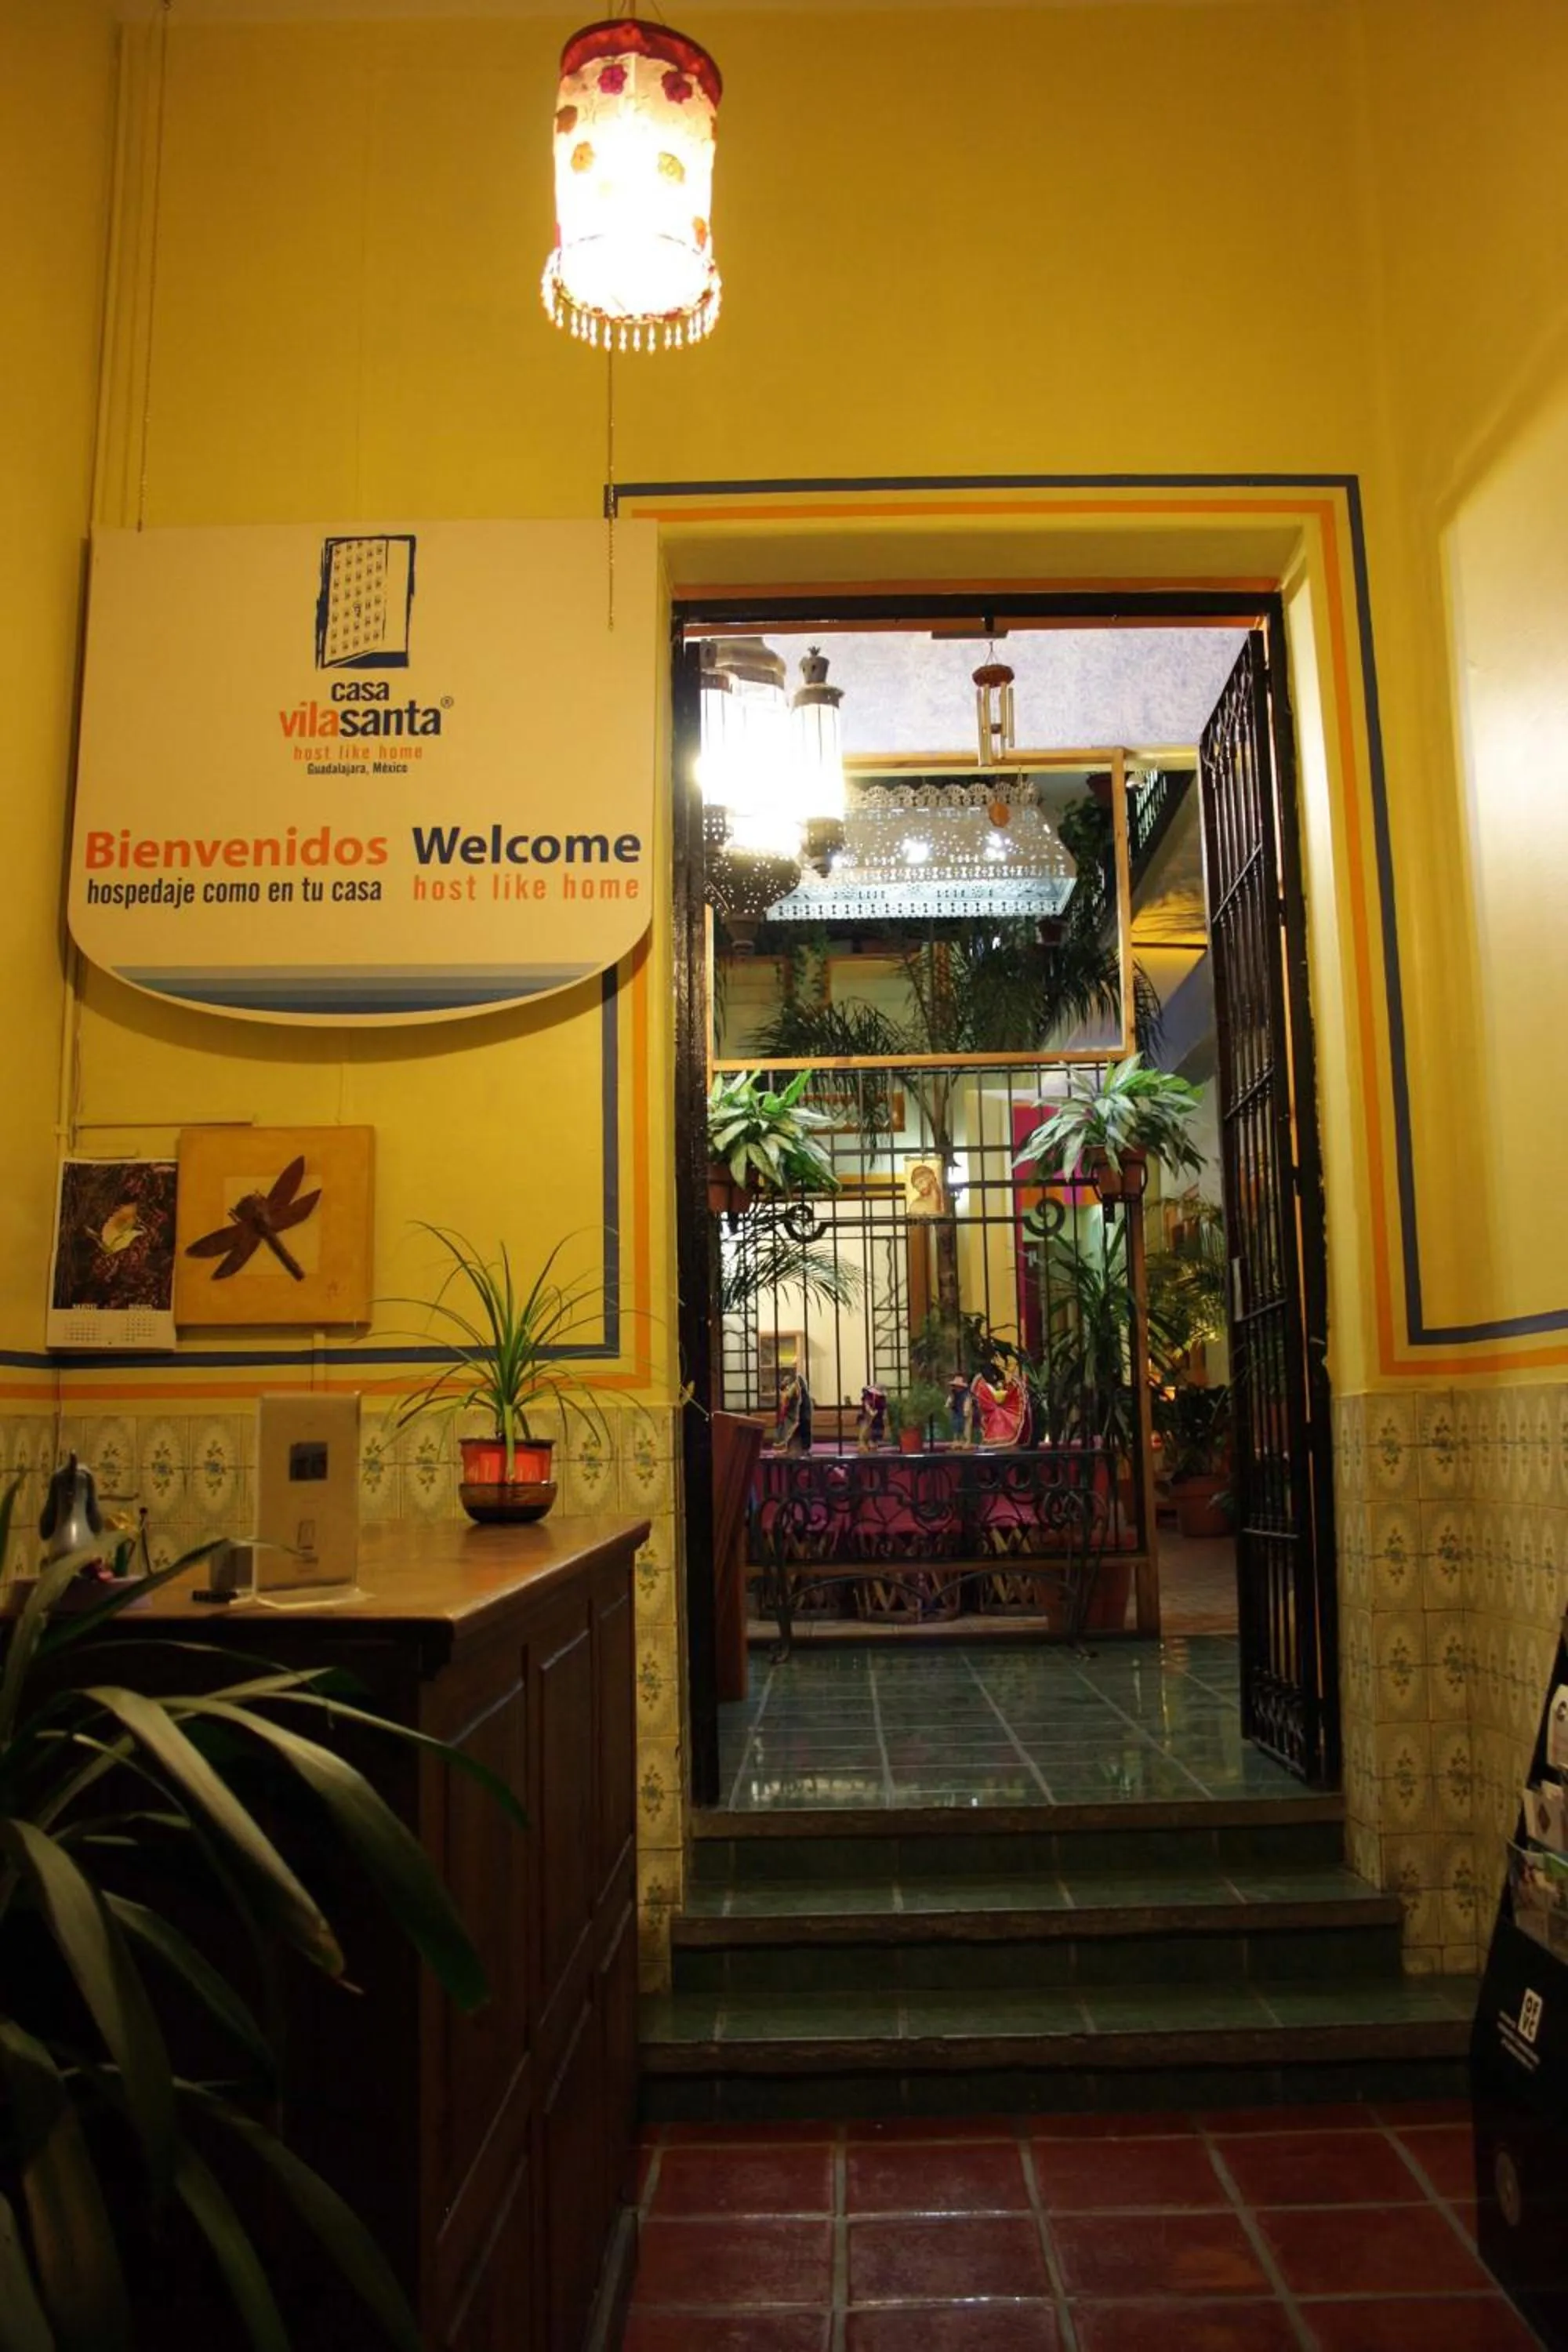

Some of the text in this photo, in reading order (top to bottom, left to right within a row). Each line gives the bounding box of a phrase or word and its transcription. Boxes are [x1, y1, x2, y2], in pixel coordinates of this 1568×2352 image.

[331, 681, 390, 702] casa
[293, 745, 423, 760] host like home
[372, 761, 408, 773] México
[85, 826, 389, 869] Bienvenidos
[412, 824, 641, 864] Welcome
[87, 877, 383, 909] hospedaje como en tu casa
[413, 873, 640, 901] host like home
